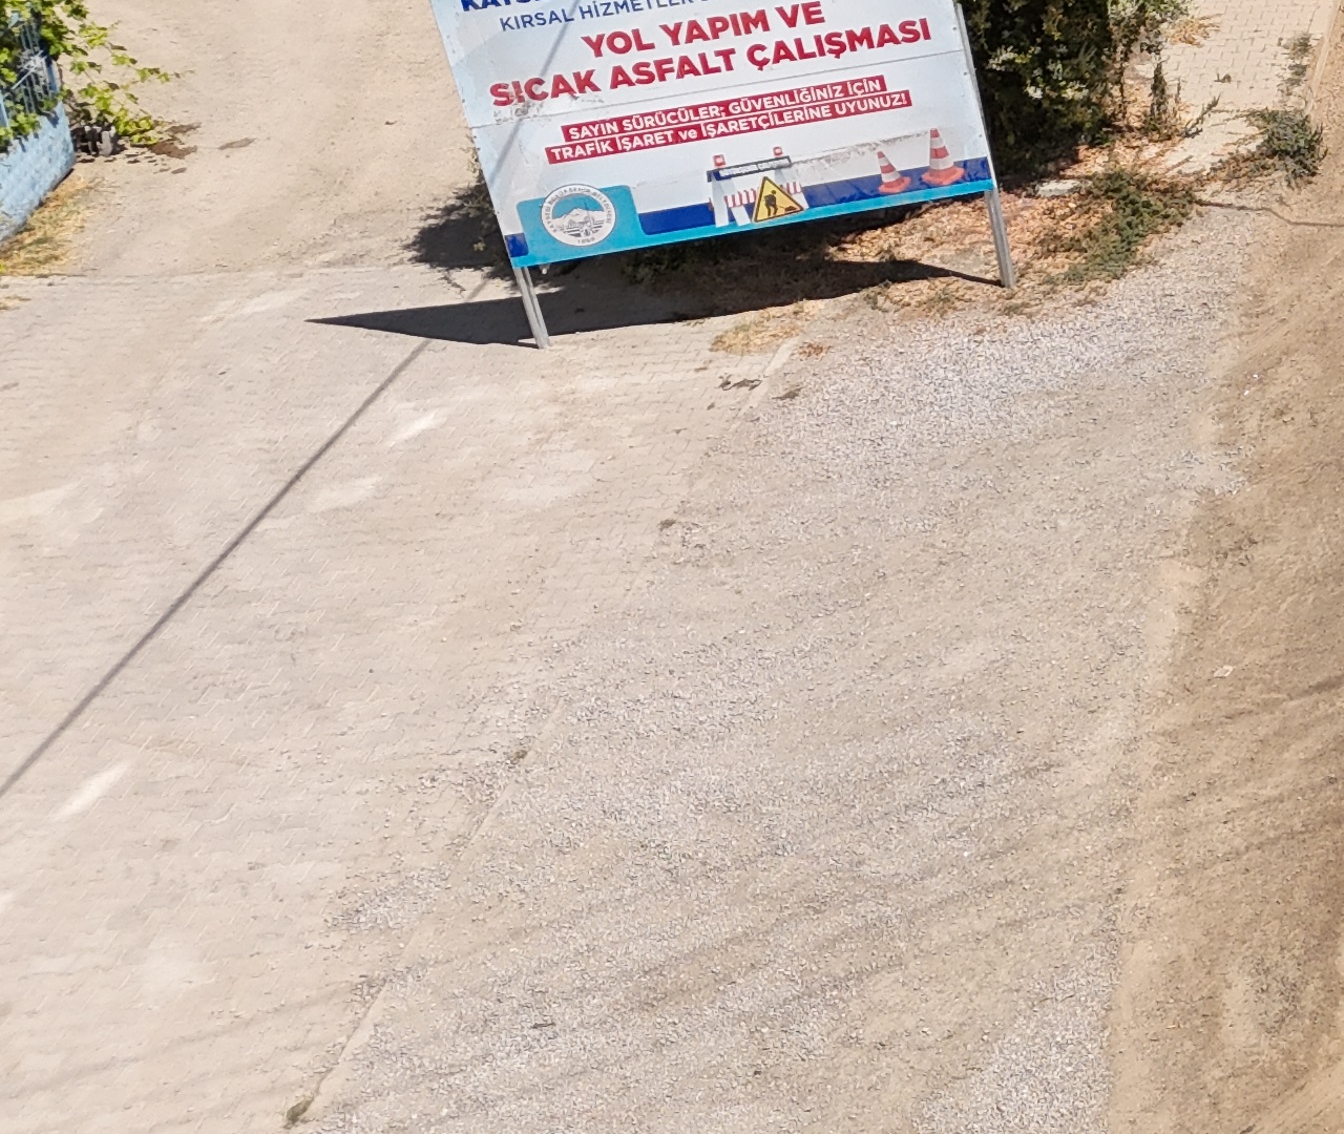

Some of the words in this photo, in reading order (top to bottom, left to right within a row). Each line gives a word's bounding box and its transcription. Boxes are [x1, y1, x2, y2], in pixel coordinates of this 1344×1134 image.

[500, 8, 574, 31] KIRSAL
[581, 28, 655, 58] YOL
[659, 8, 770, 46] YAPIM
[775, 1, 825, 28] VE
[489, 69, 601, 107] SICAK
[609, 48, 736, 90] ASFALT
[746, 18, 932, 71] ÇALIŞMASI
[551, 139, 614, 161] TRAFİK
[616, 130, 674, 152] İŞARET
[678, 129, 698, 141] ve
[701, 103, 833, 138] İŞARETÇİLERİNE
[834, 92, 908, 115] UYUNUZ!
[568, 121, 619, 140] SAYIN
[623, 105, 726, 132] SÜRÜCÜLER;
[728, 84, 844, 114] GÜVENLİĞİNİZ
[848, 78, 882, 97] İÇİN
